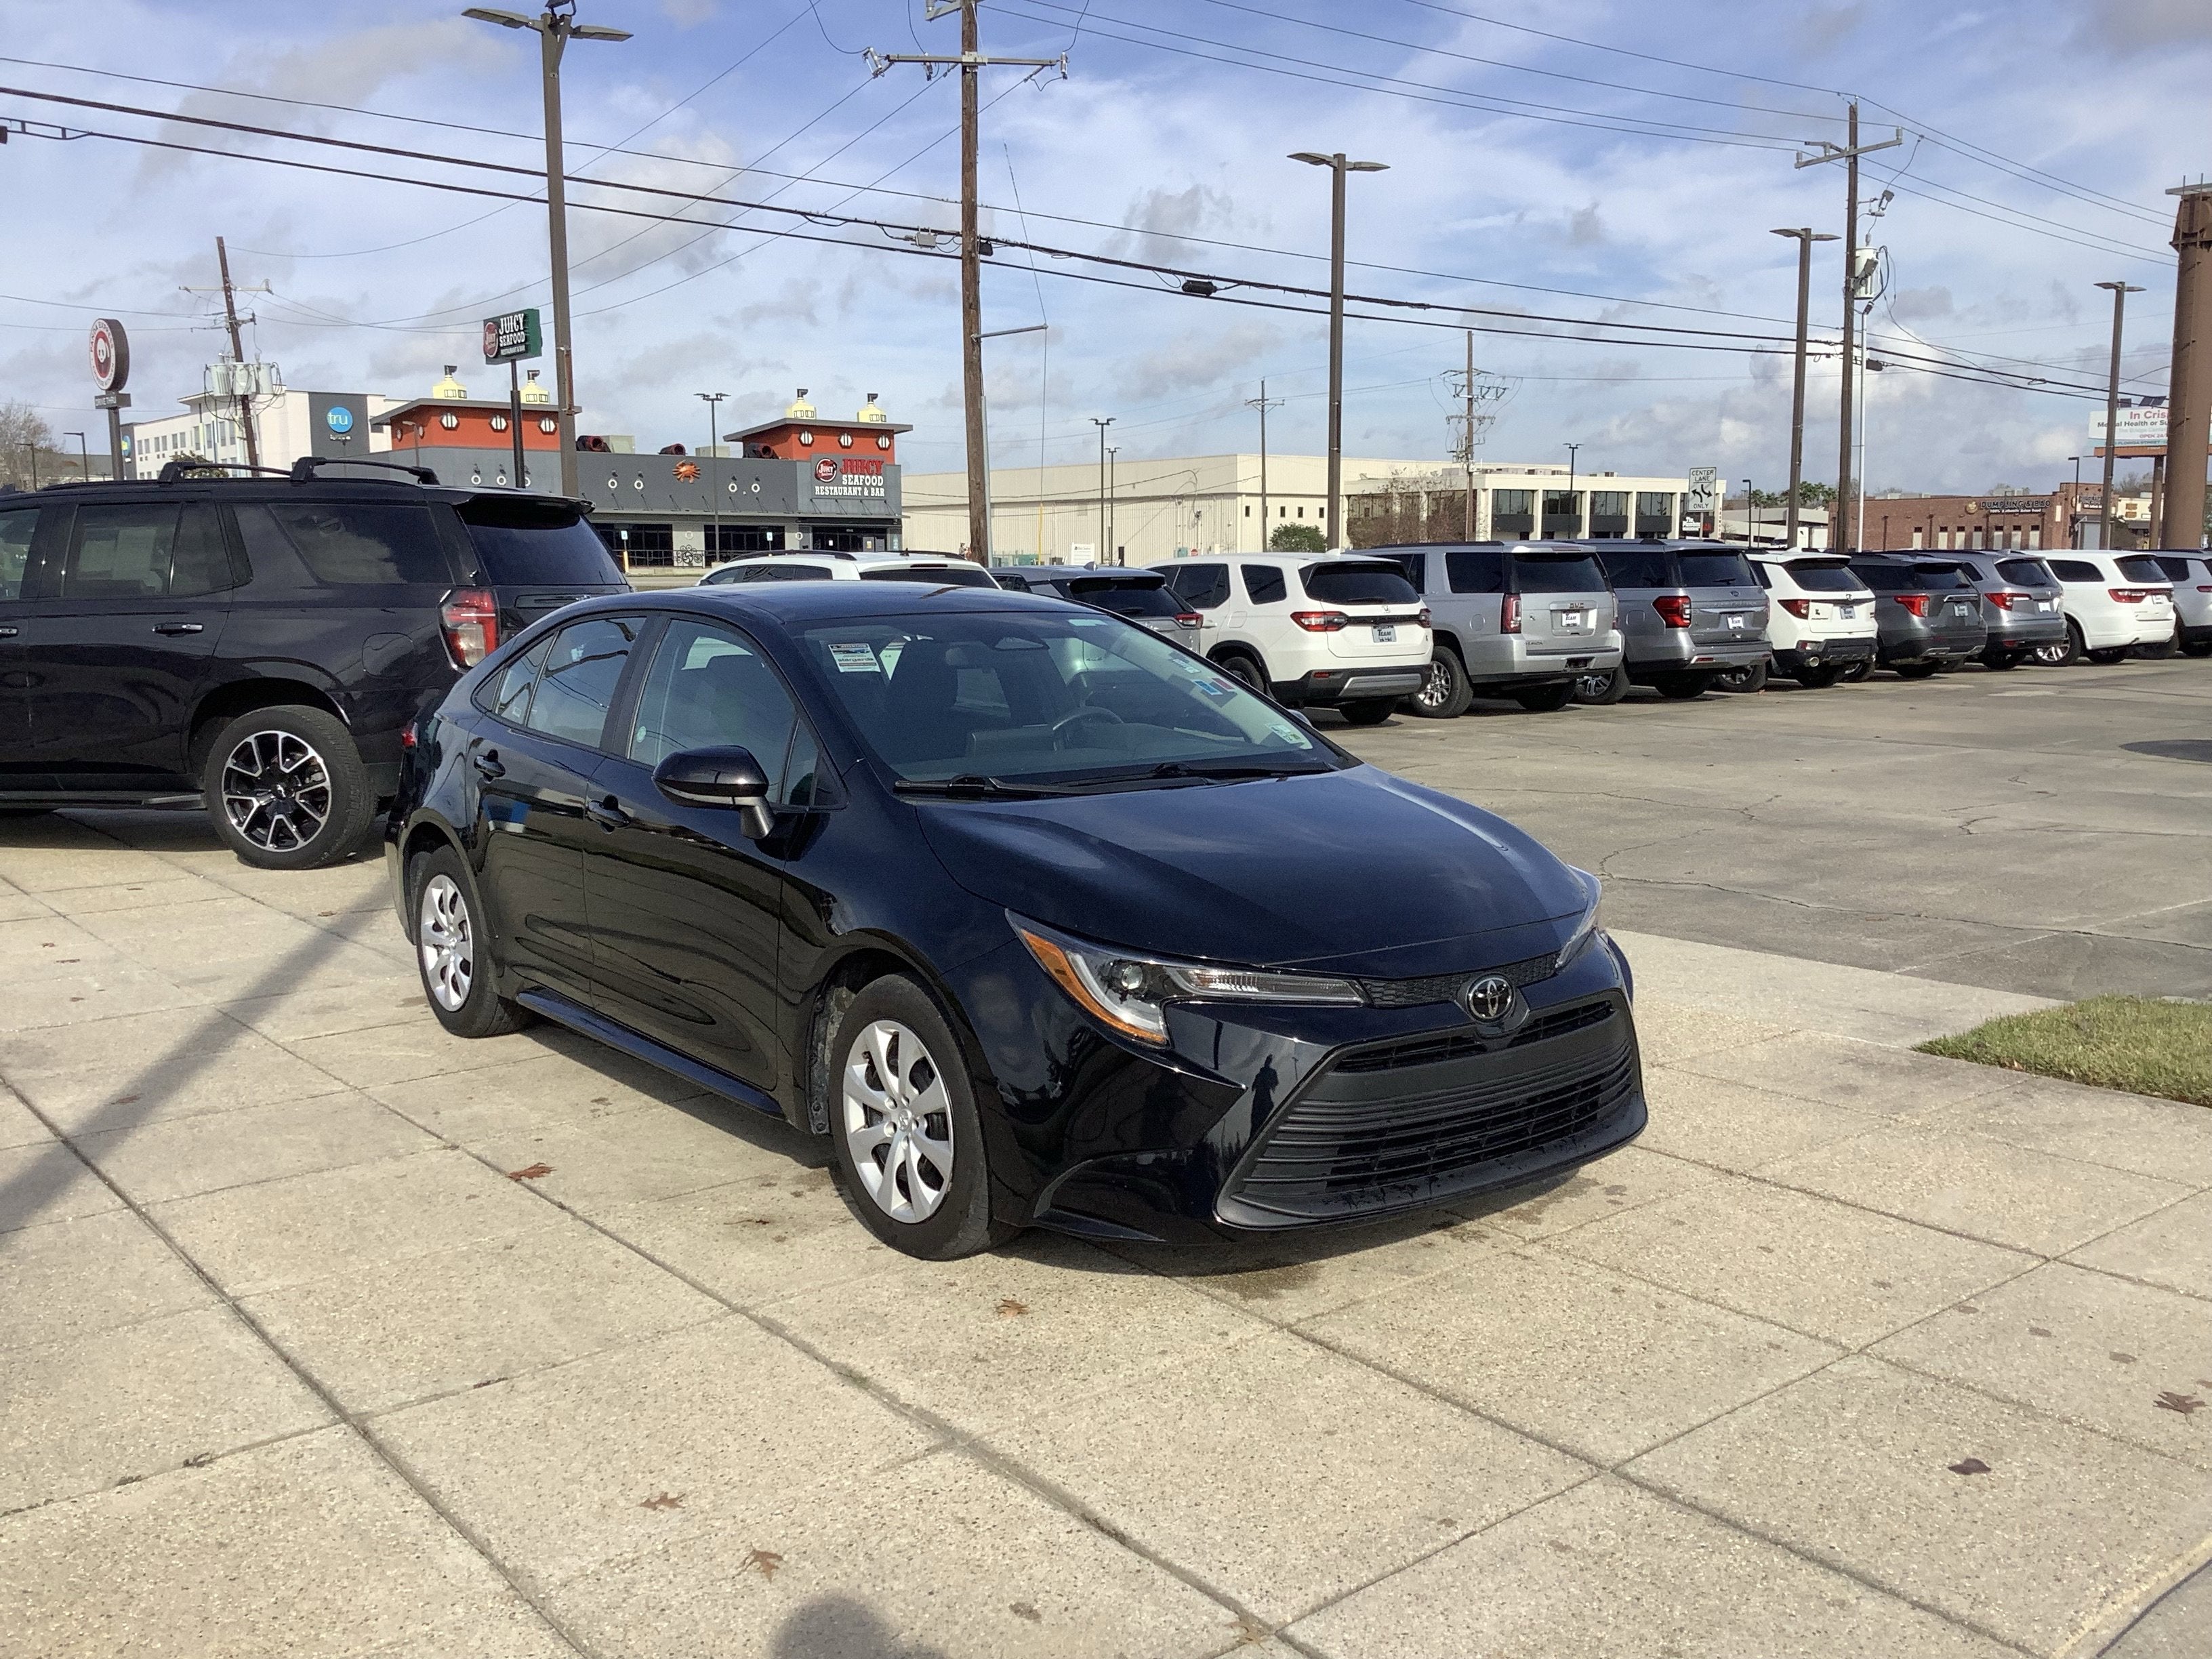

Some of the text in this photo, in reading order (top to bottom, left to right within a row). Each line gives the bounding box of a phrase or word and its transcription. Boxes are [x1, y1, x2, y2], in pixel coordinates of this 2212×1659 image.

[499, 314, 524, 335] JUICY
[499, 331, 525, 347] SEAFOOD
[327, 412, 348, 425] tru
[2130, 410, 2169, 419] In Cris
[840, 459, 884, 475] JUICY
[842, 474, 884, 486] SEAFOOD
[815, 486, 884, 497] RESTAURANT & BAR
[2025, 500, 2031, 508] &
[2034, 499, 2051, 508] BAO
